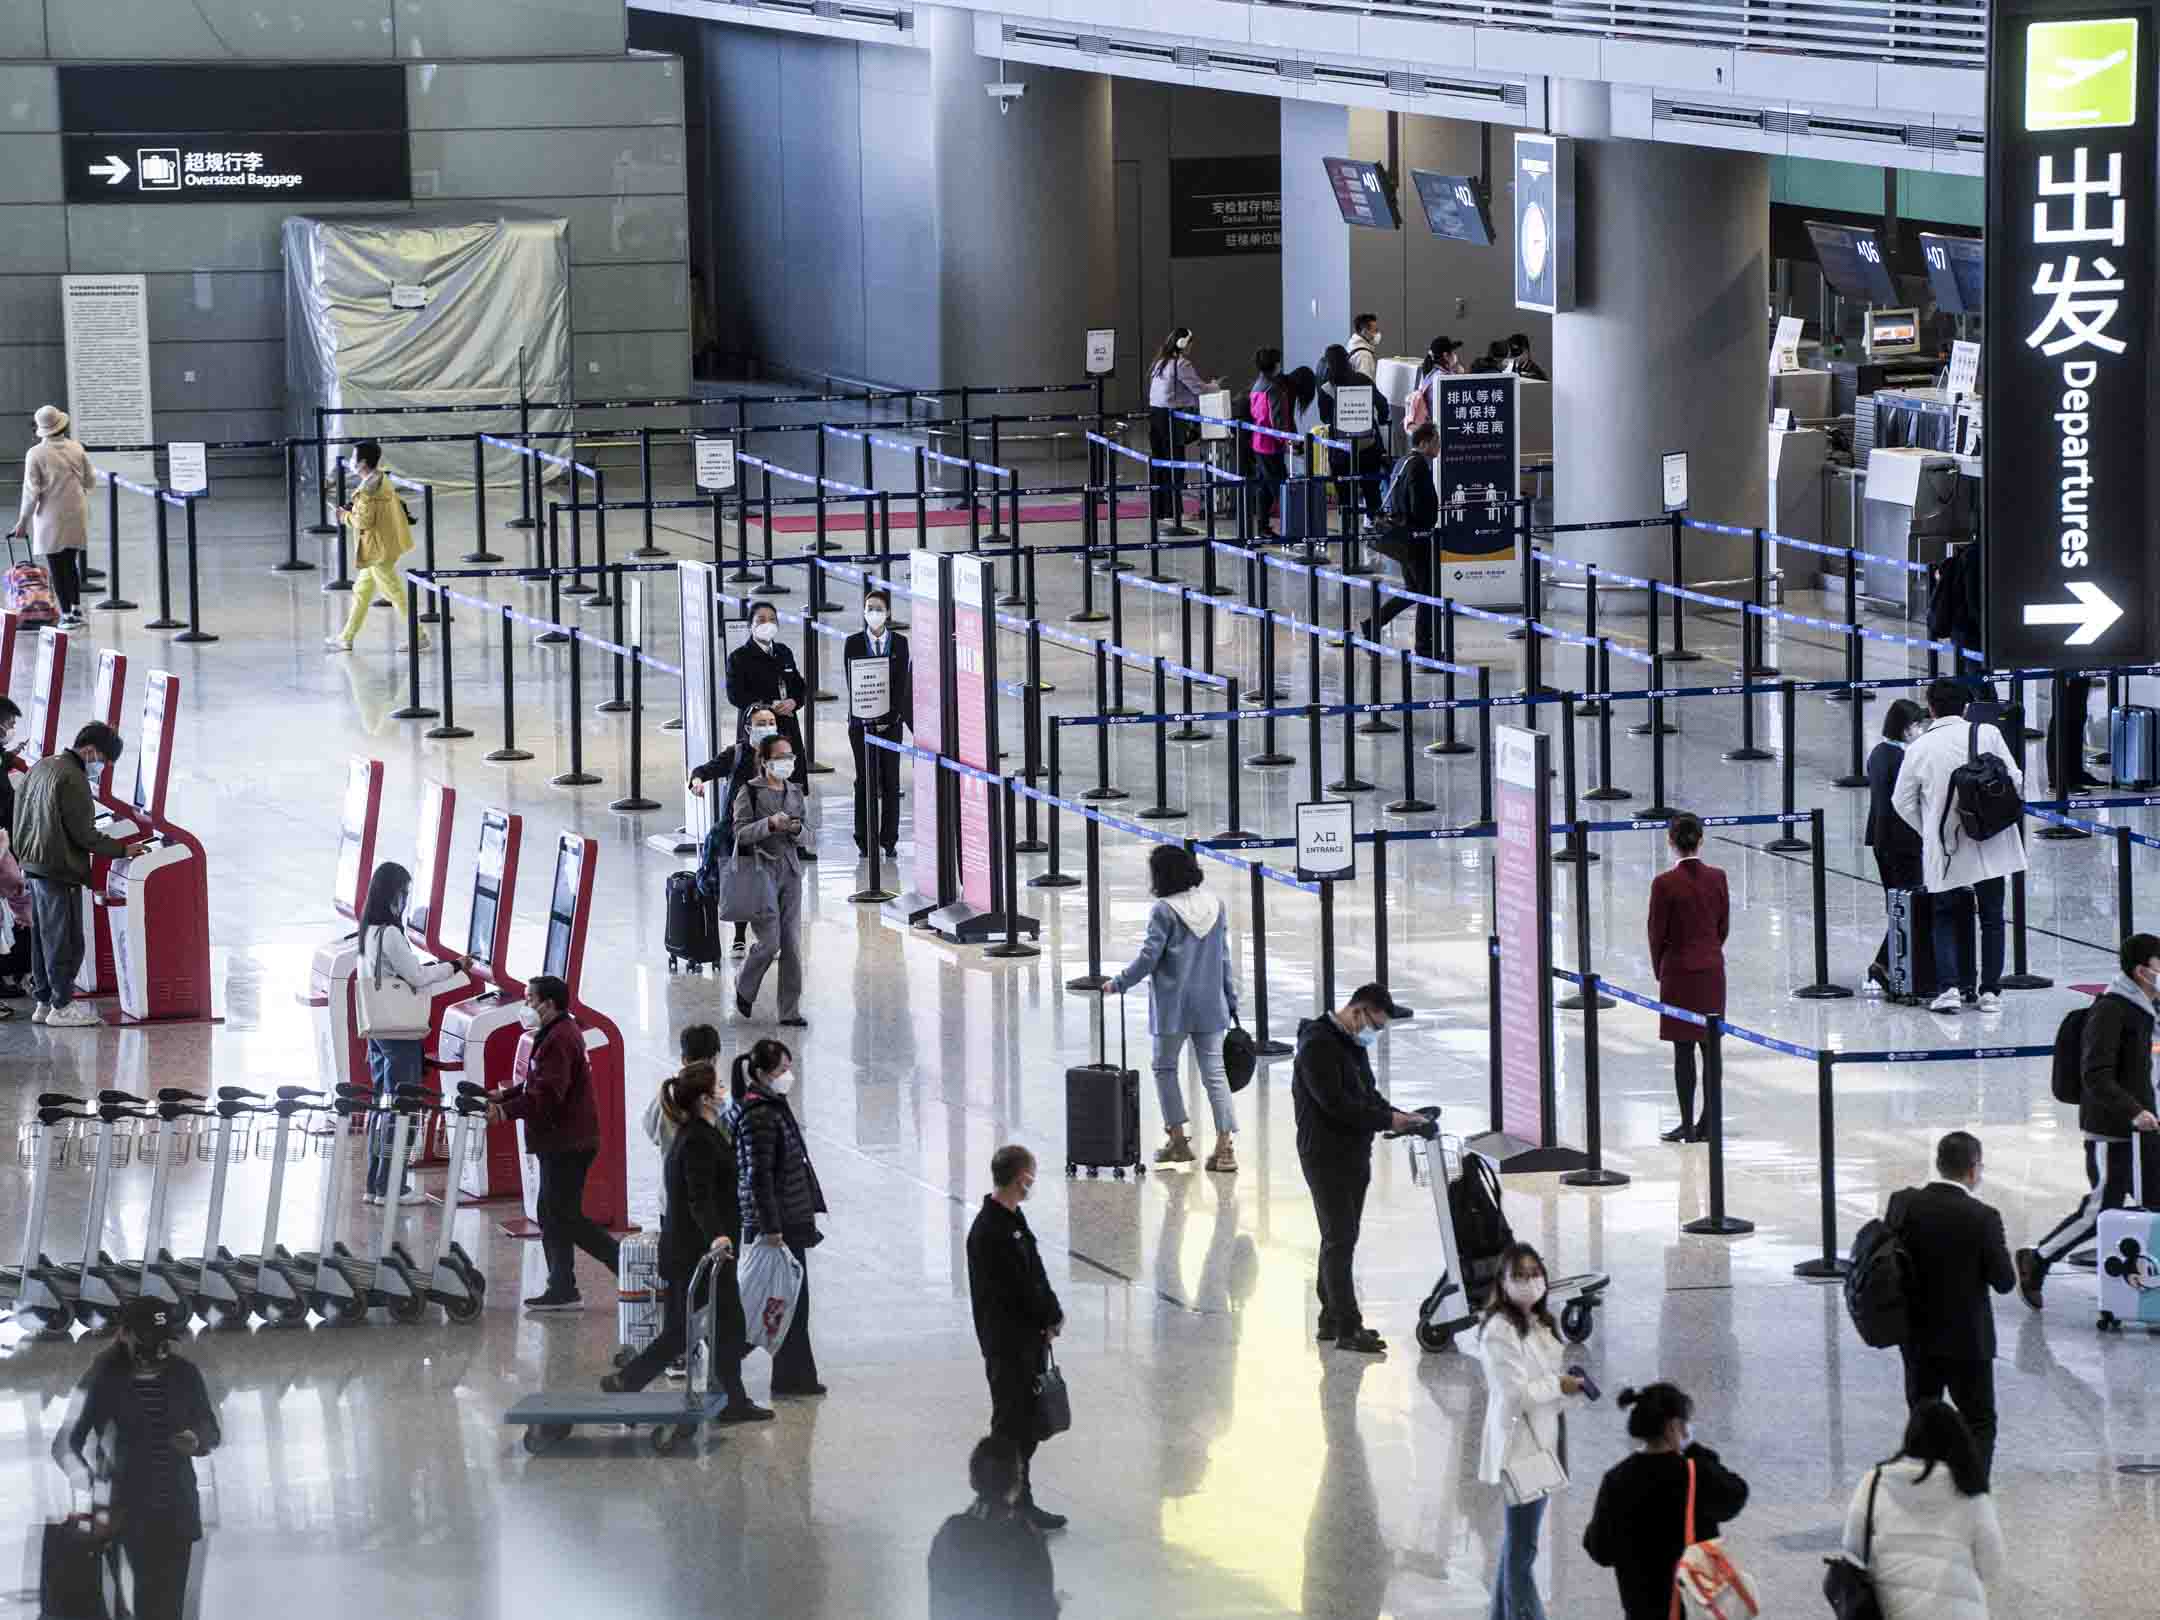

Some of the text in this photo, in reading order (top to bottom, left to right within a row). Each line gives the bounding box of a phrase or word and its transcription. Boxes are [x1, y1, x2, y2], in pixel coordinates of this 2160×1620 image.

[184, 152, 264, 172] 超规行李
[185, 173, 303, 188] Oversized Baggage
[1856, 240, 1881, 264] A06
[1926, 246, 1947, 271] A07
[2025, 147, 2127, 357] 出发
[1447, 389, 1504, 404] 排队等候
[1455, 405, 1497, 419] 请保持
[1447, 421, 1504, 434] 一米距离
[2054, 360, 2097, 569] Departures
[1313, 831, 1337, 843] 入口
[1306, 845, 1344, 854] ENTRANCE
